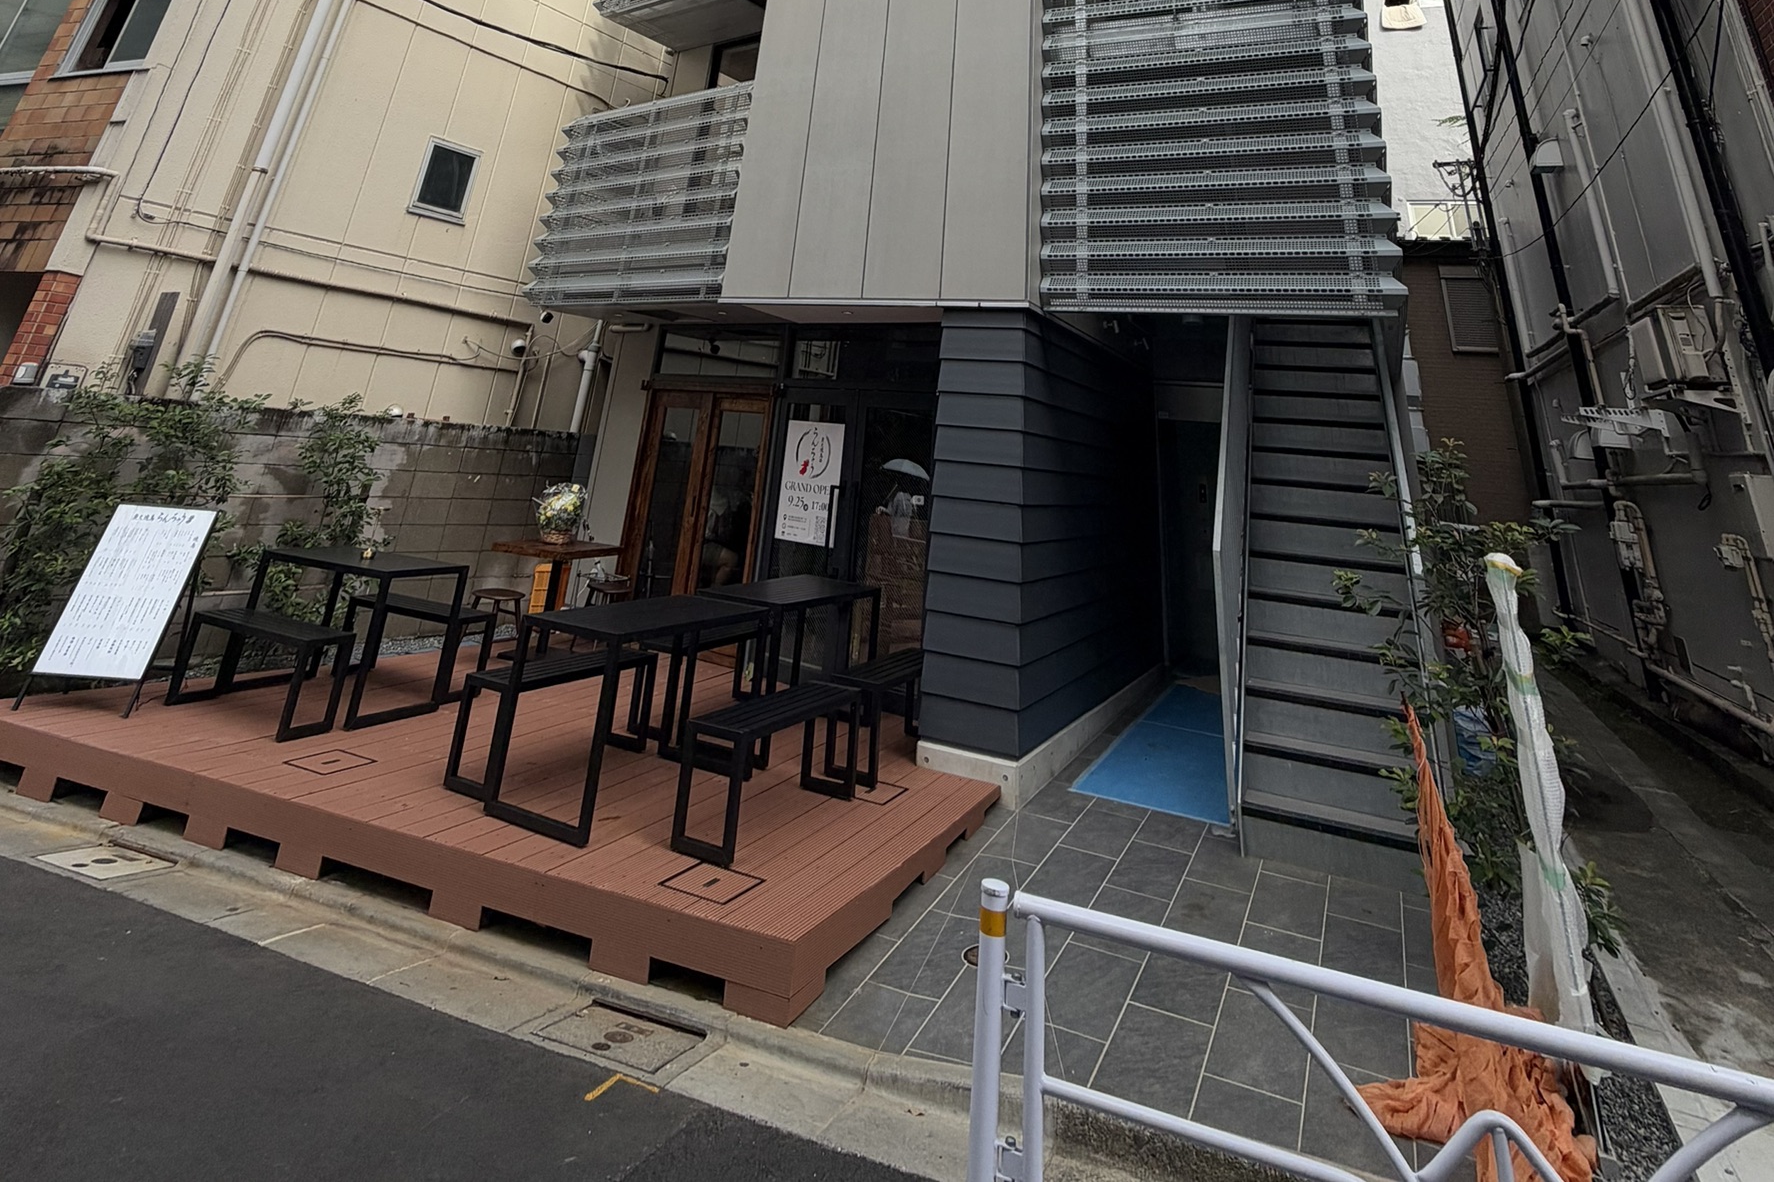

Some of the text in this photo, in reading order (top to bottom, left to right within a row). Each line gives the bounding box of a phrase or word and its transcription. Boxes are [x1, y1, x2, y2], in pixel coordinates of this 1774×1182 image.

[785, 480, 830, 496] GRAND OPE
[788, 495, 805, 510] 9.25
